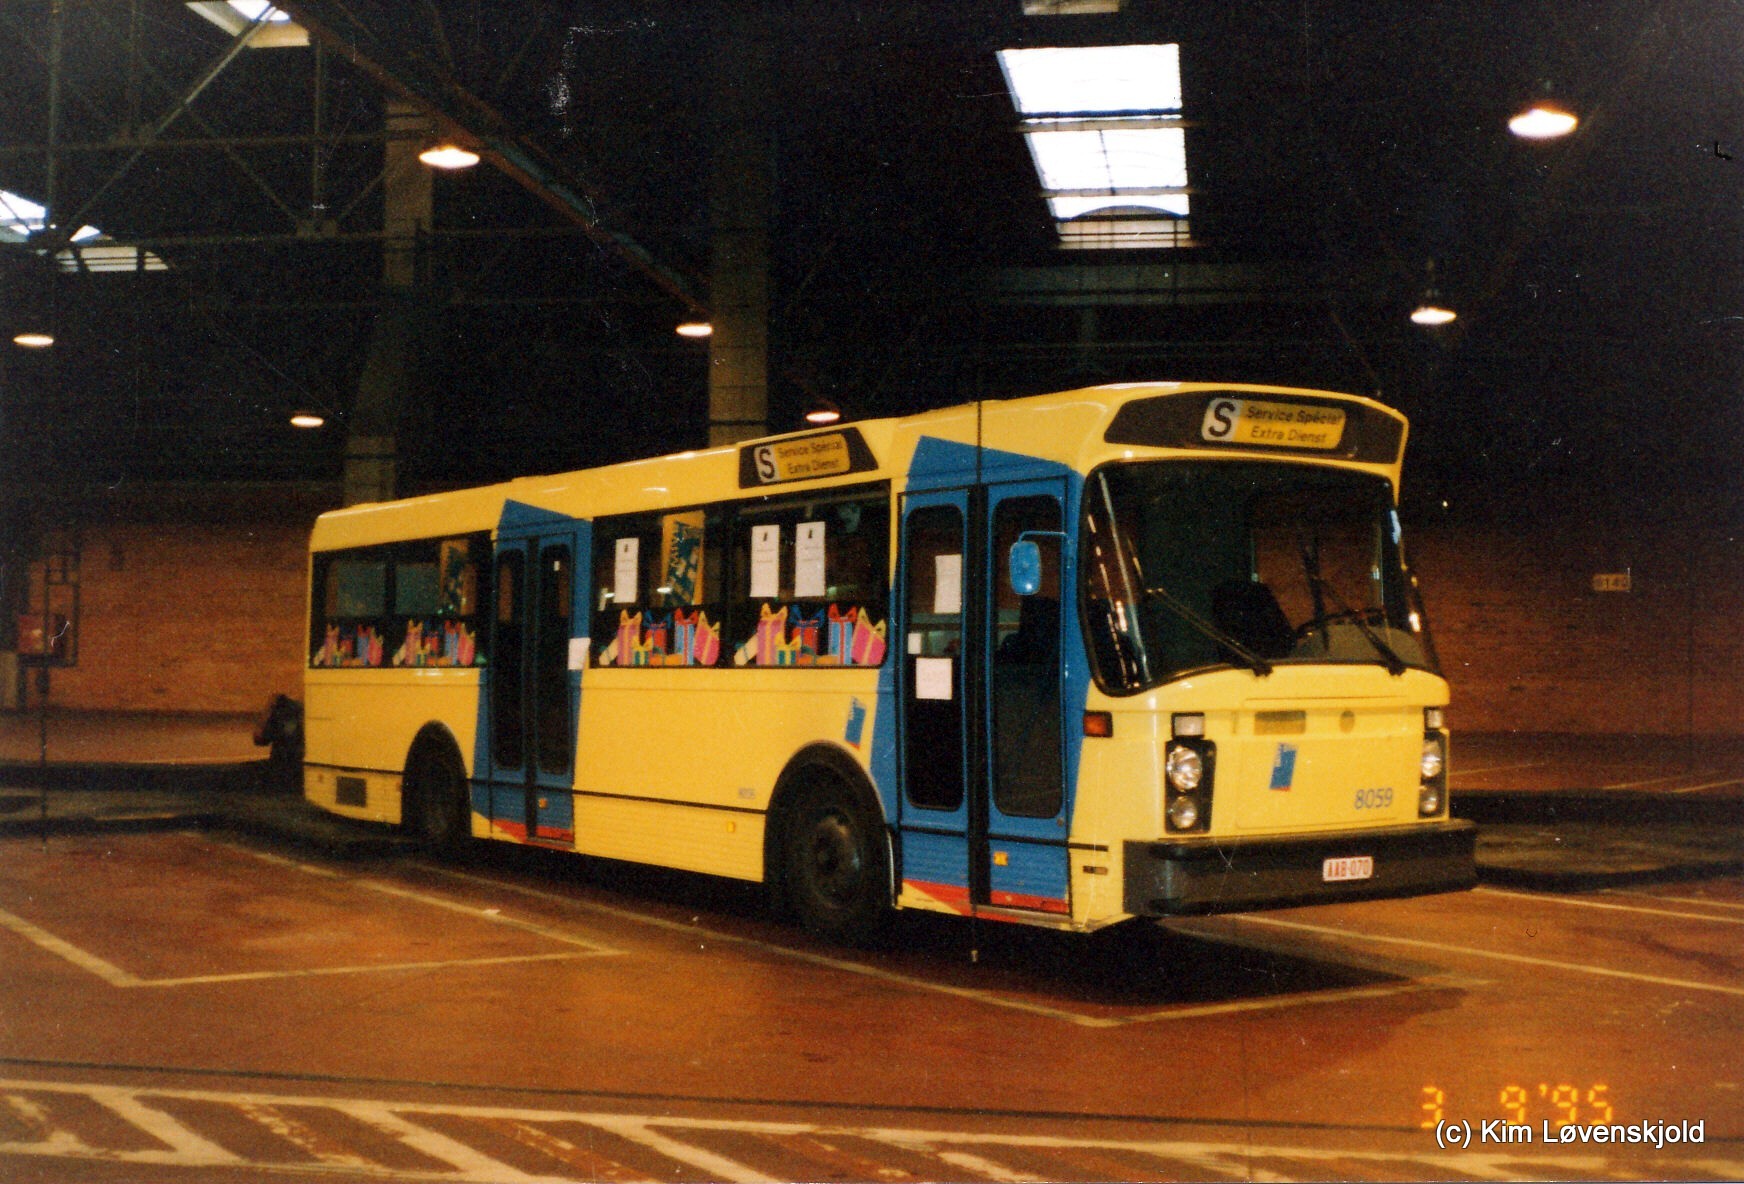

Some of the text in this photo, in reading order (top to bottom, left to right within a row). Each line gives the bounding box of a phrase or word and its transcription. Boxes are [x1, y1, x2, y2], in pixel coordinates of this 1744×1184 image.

[1208, 401, 1236, 437] S
[1247, 406, 1293, 422] Service
[1251, 426, 1328, 443] Extra Dienst
[759, 448, 775, 478] S
[1355, 787, 1393, 809] 8059
